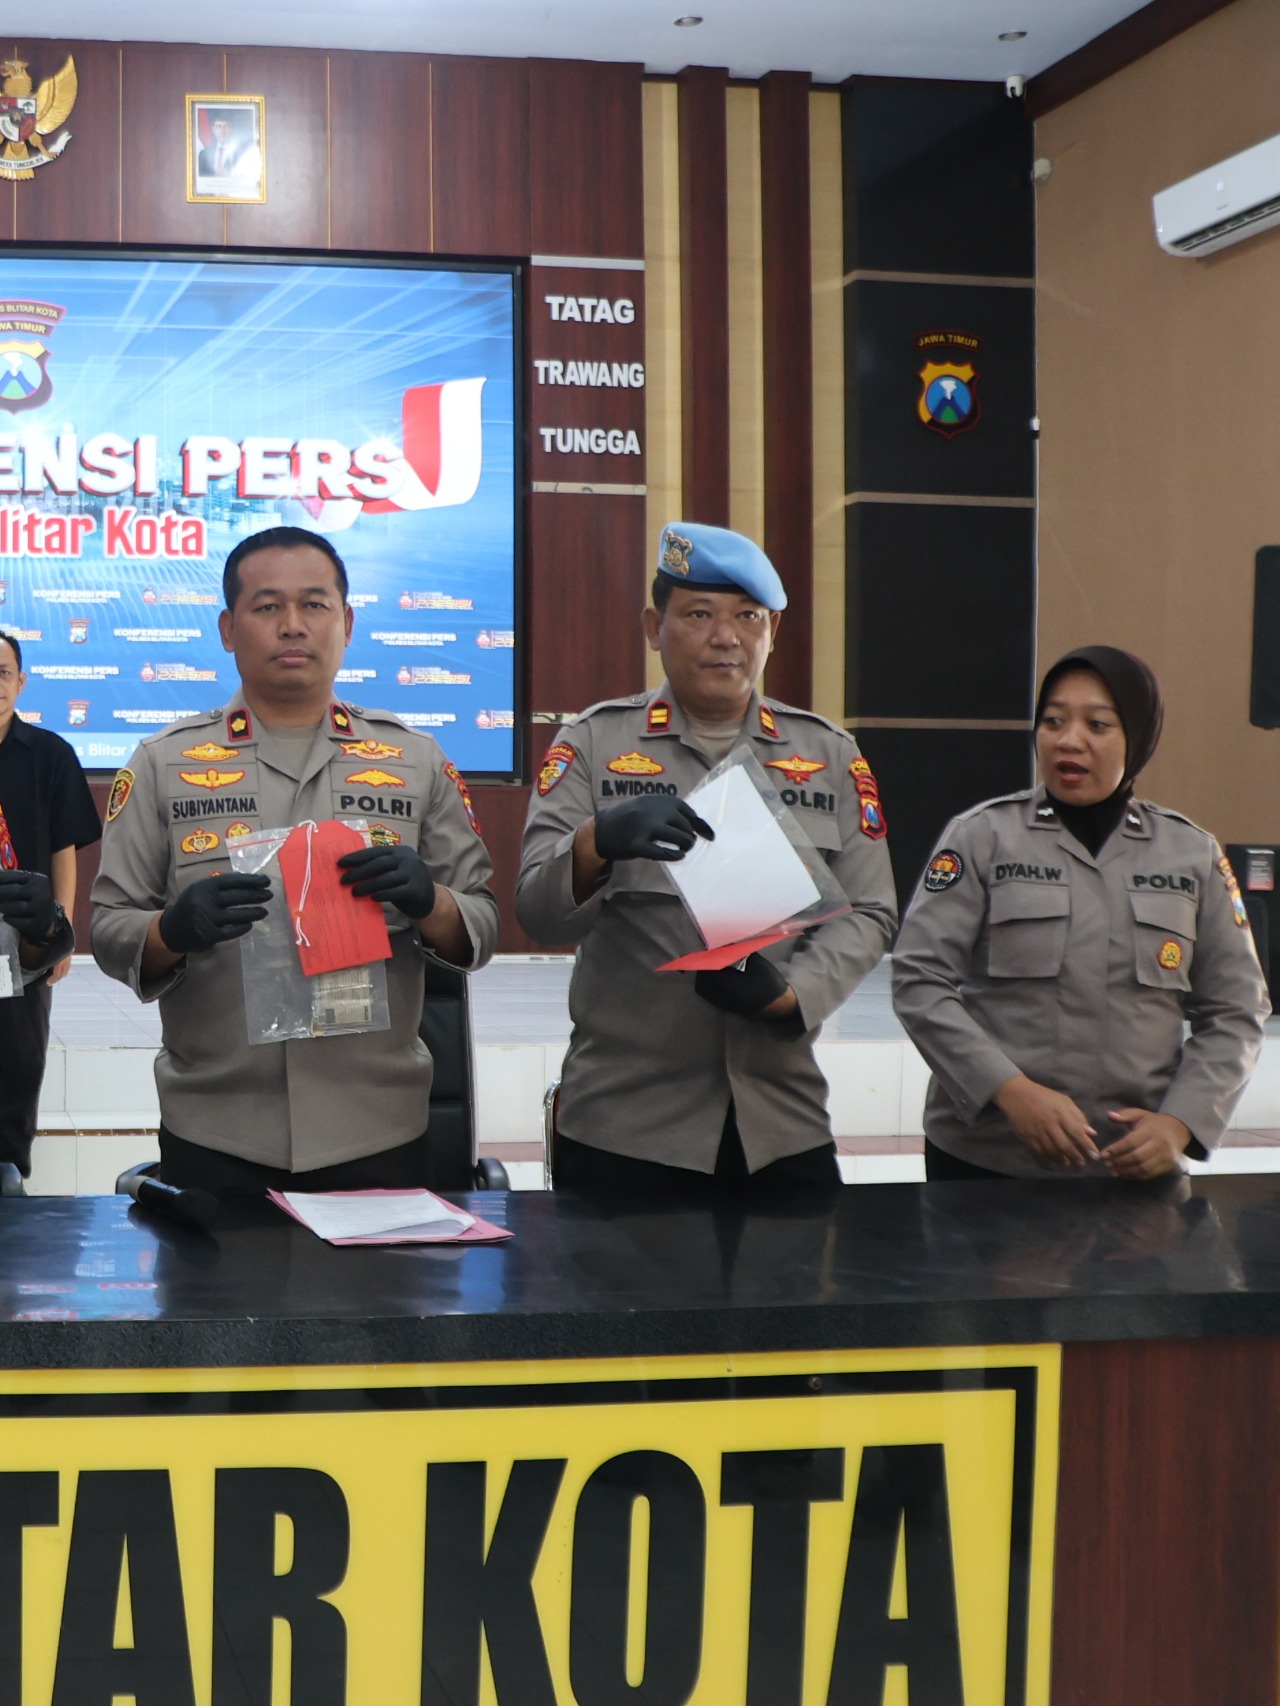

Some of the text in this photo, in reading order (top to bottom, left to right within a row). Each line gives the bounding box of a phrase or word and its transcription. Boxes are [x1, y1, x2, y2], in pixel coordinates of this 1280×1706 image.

[6, 304, 34, 314] BLITAR
[36, 307, 58, 318] KOTA
[544, 295, 635, 324] TATAG
[14, 321, 47, 333] TIMUR
[918, 334, 979, 348] JAWA TIMUR
[533, 360, 645, 388] TRAWANG
[539, 427, 642, 455] TUNGGA
[181, 434, 407, 501] PERS
[106, 508, 205, 557] Kota
[31, 666, 119, 674] KONFERENSI PERS
[88, 742, 128, 757] Blitar
[172, 797, 257, 819] SUBIYANTANA
[340, 794, 412, 818] POLRI
[995, 863, 1062, 881] DYAH.W
[420, 1443, 966, 1706] KOTA
